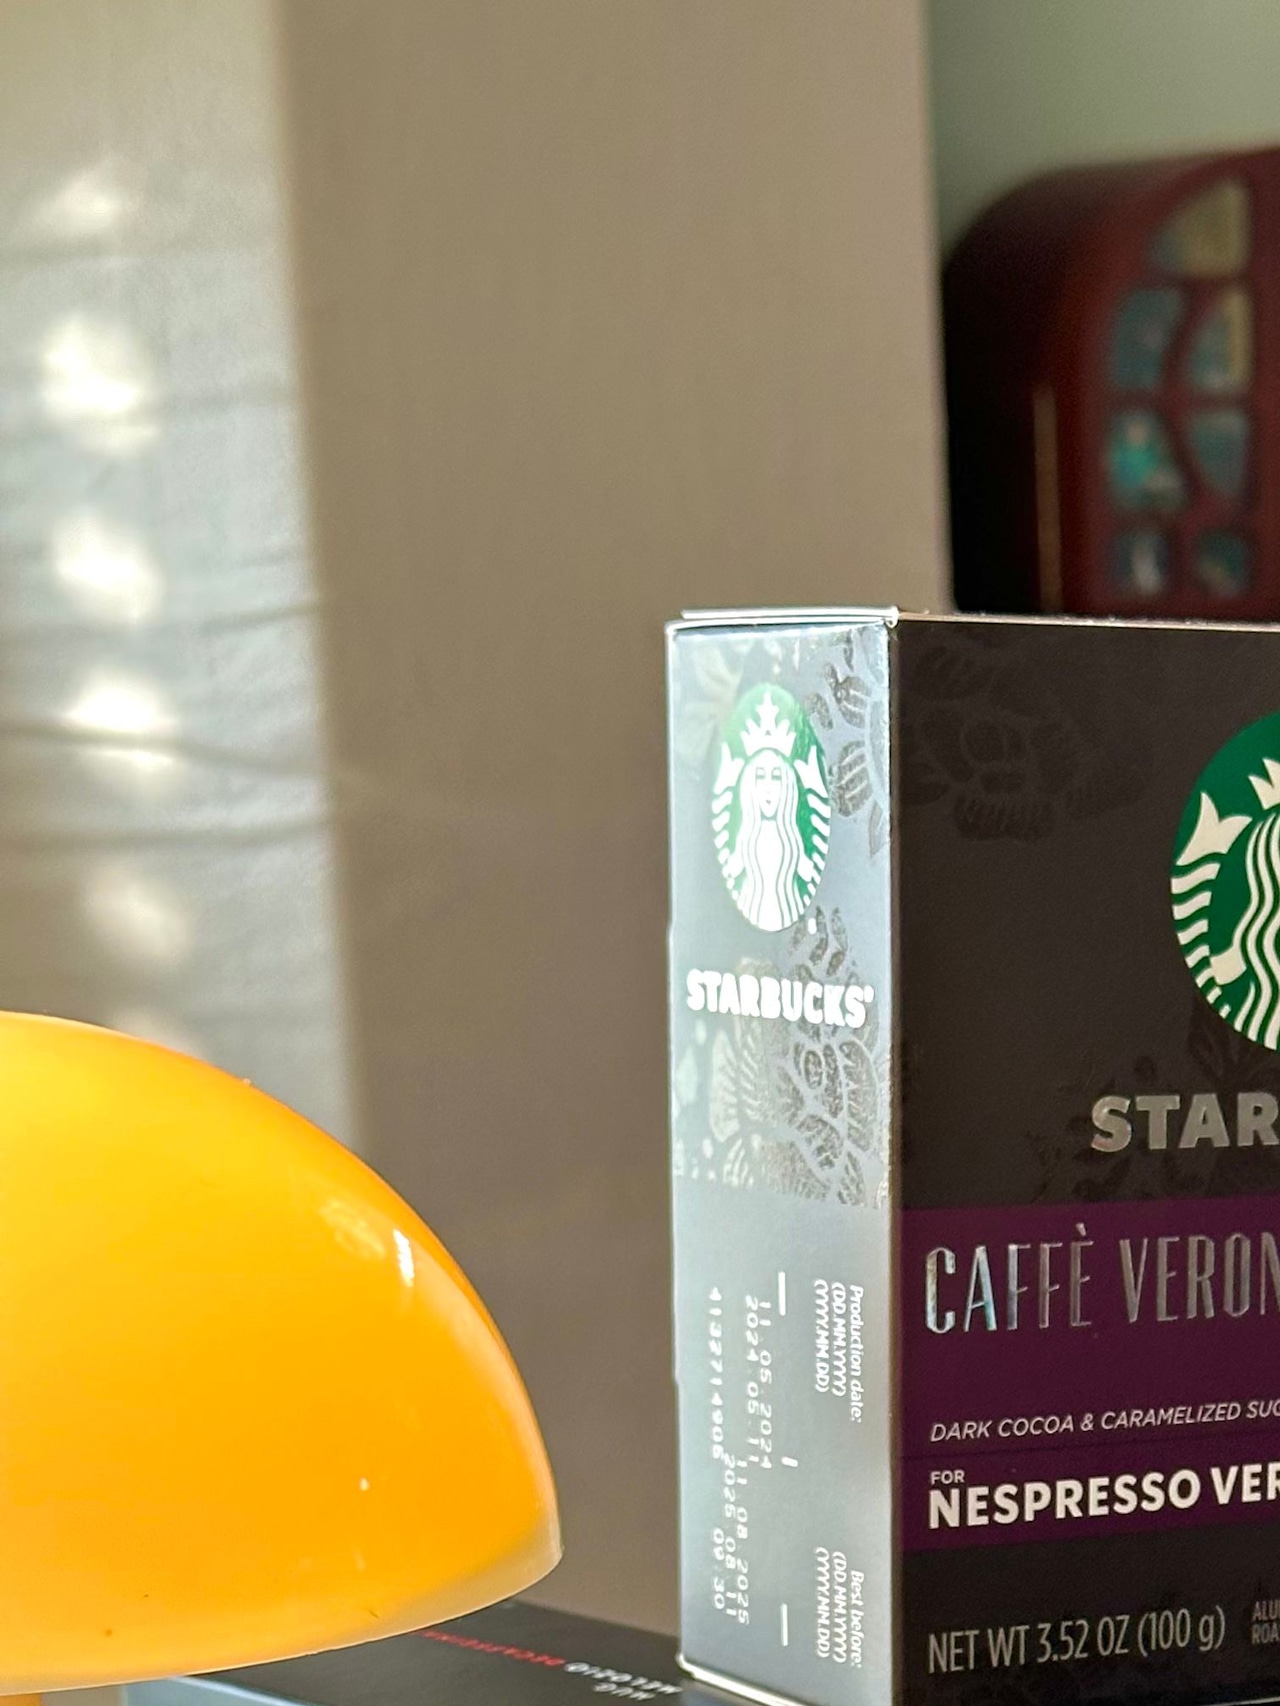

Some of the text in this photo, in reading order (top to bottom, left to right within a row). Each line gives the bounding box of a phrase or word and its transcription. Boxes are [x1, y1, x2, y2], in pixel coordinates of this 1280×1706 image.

[926, 1222, 1094, 1334] CAFFÈ
[848, 1284, 866, 1424] Production date:
[930, 1421, 990, 1442] DARK
[999, 1414, 1075, 1437] COCOA
[1081, 1413, 1095, 1433] &
[1101, 1401, 1241, 1431] CARAMELIZED
[928, 1470, 1201, 1530] NESPRESSO
[929, 1470, 966, 1486] FOR
[848, 1569, 865, 1669] Best before:
[928, 1607, 1227, 1675] NET WT 3.52 OZ (100 g)
